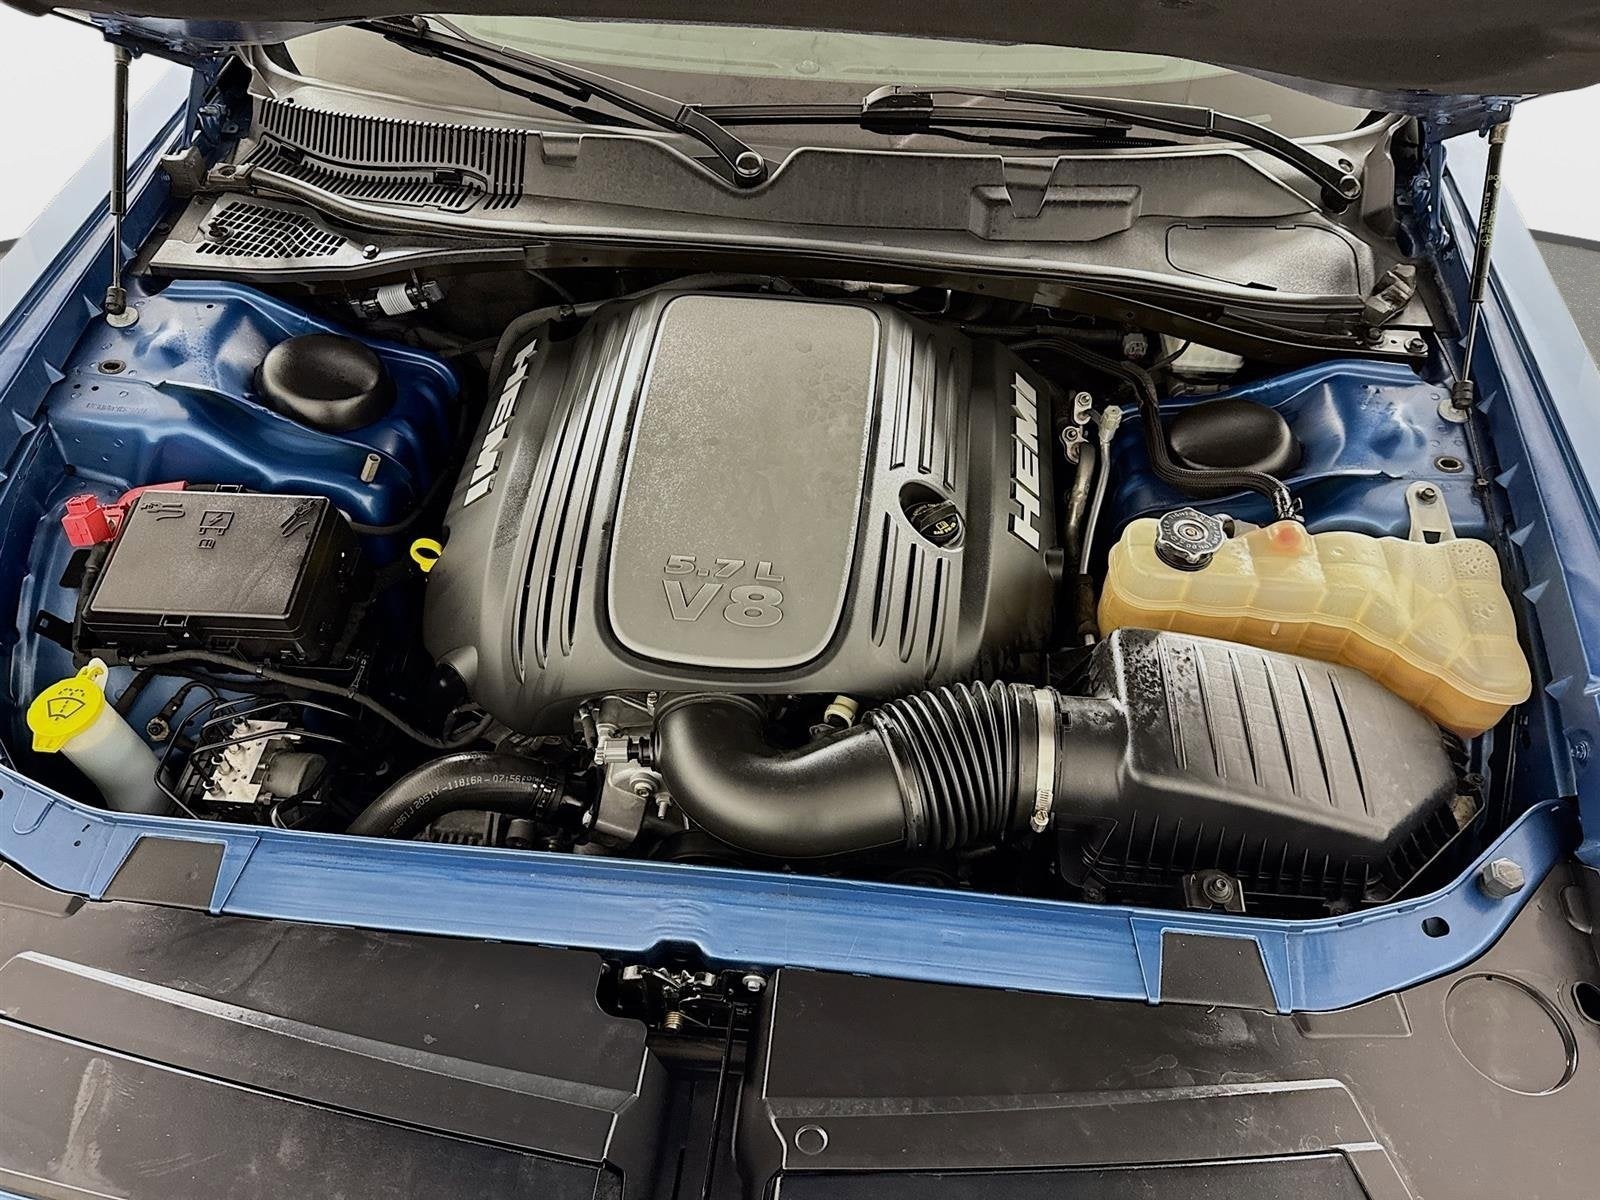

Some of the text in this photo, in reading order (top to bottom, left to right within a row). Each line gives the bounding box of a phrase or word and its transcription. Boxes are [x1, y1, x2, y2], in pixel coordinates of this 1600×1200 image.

[464, 338, 538, 507] HEMI
[1010, 372, 1040, 551] HEMI
[662, 579, 784, 628] V8
